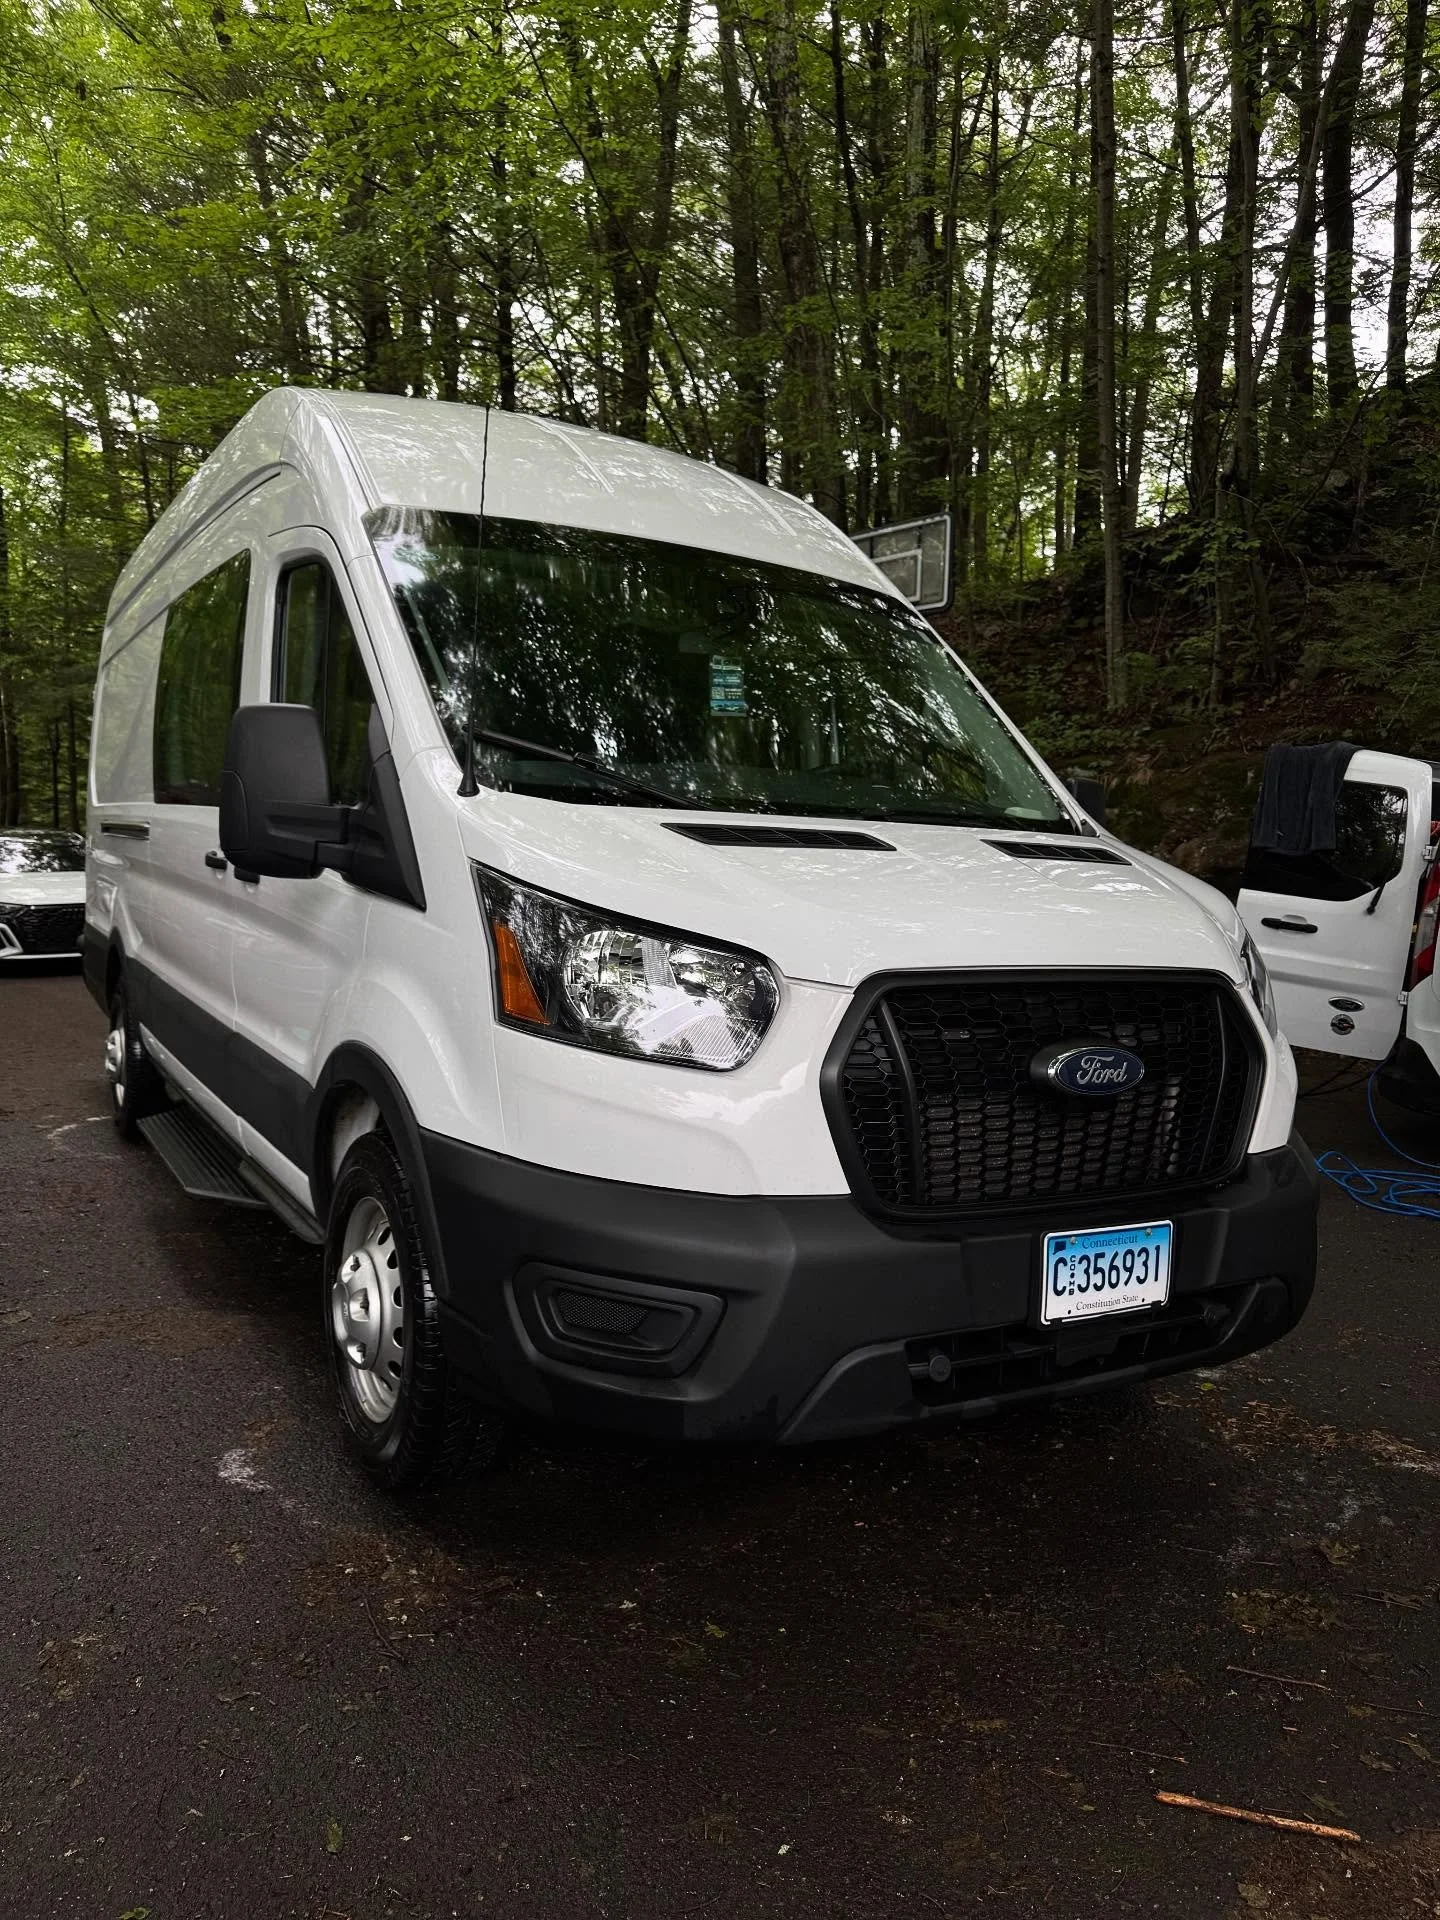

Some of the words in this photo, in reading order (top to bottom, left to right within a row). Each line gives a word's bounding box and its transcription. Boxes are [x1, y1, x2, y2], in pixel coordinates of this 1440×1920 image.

[1076, 1055, 1128, 1085] Ford
[1082, 1234, 1138, 1249] Connecticut
[1076, 1298, 1121, 1311] Constitution
[1122, 1294, 1139, 1304] State
